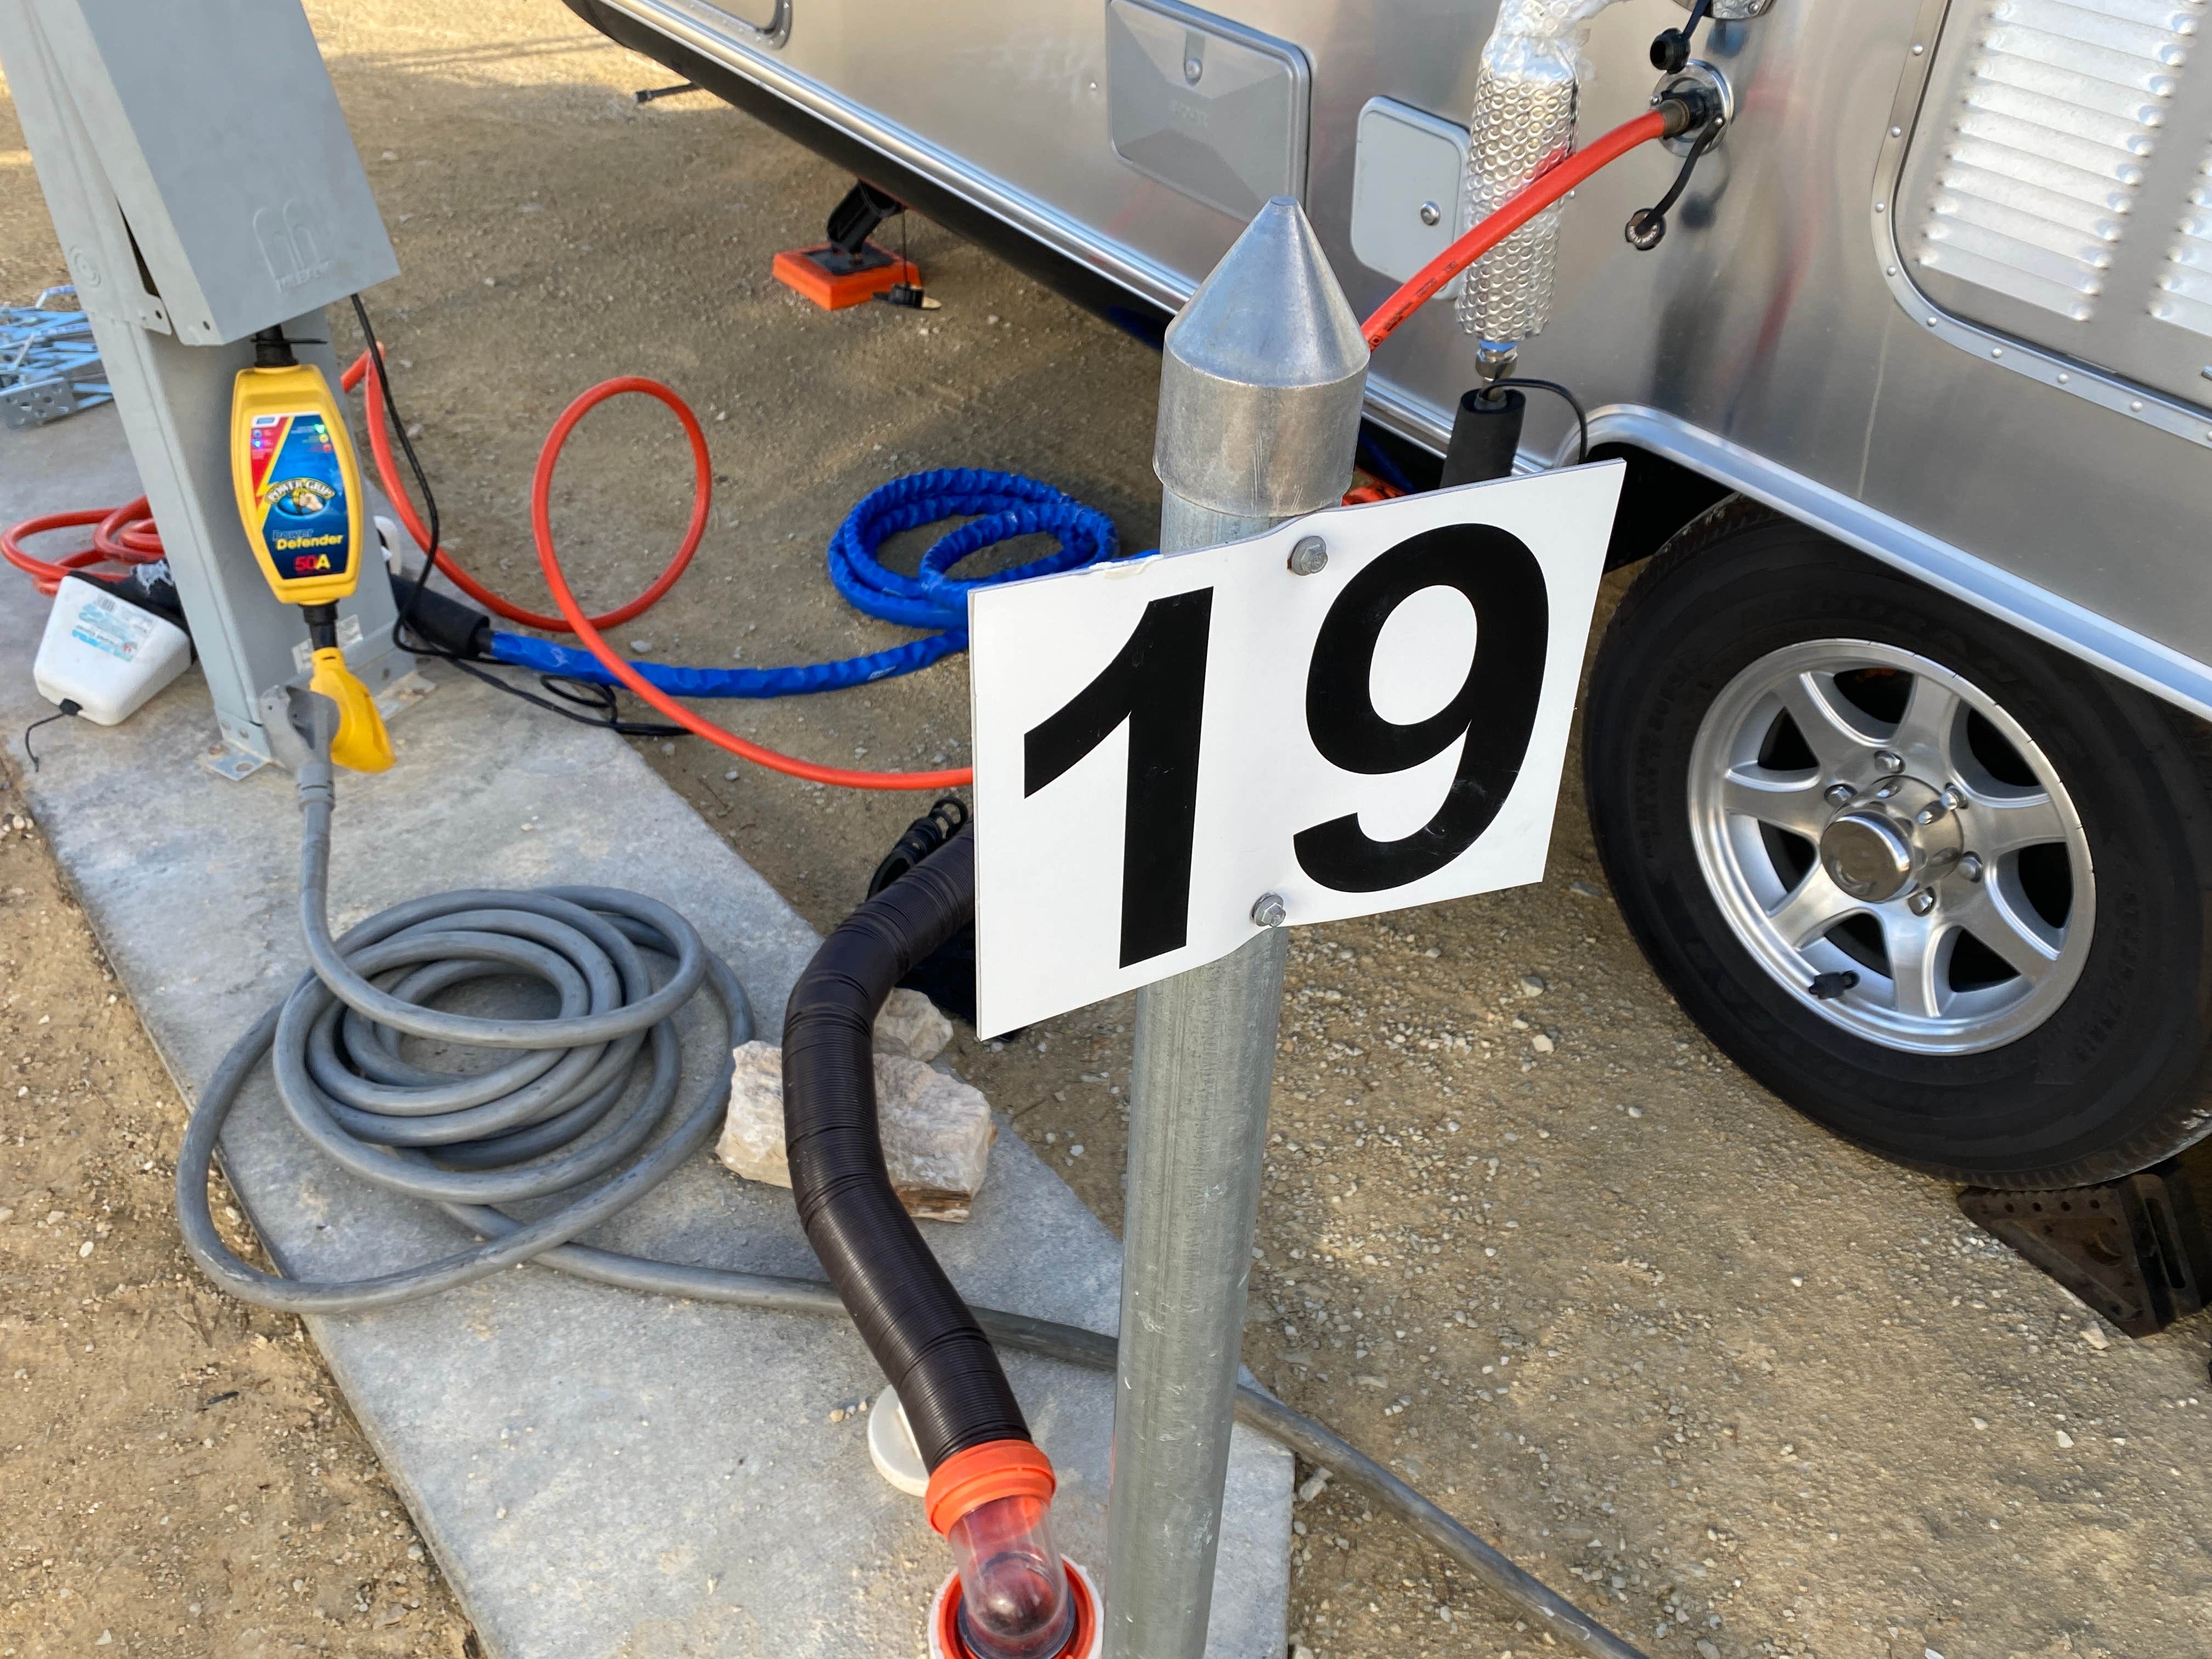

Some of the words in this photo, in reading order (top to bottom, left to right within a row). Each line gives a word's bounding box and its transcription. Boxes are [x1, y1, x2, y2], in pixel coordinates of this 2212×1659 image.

[276, 533, 344, 551] Defender
[294, 553, 331, 572] 50A
[1024, 523, 1549, 969] 19
